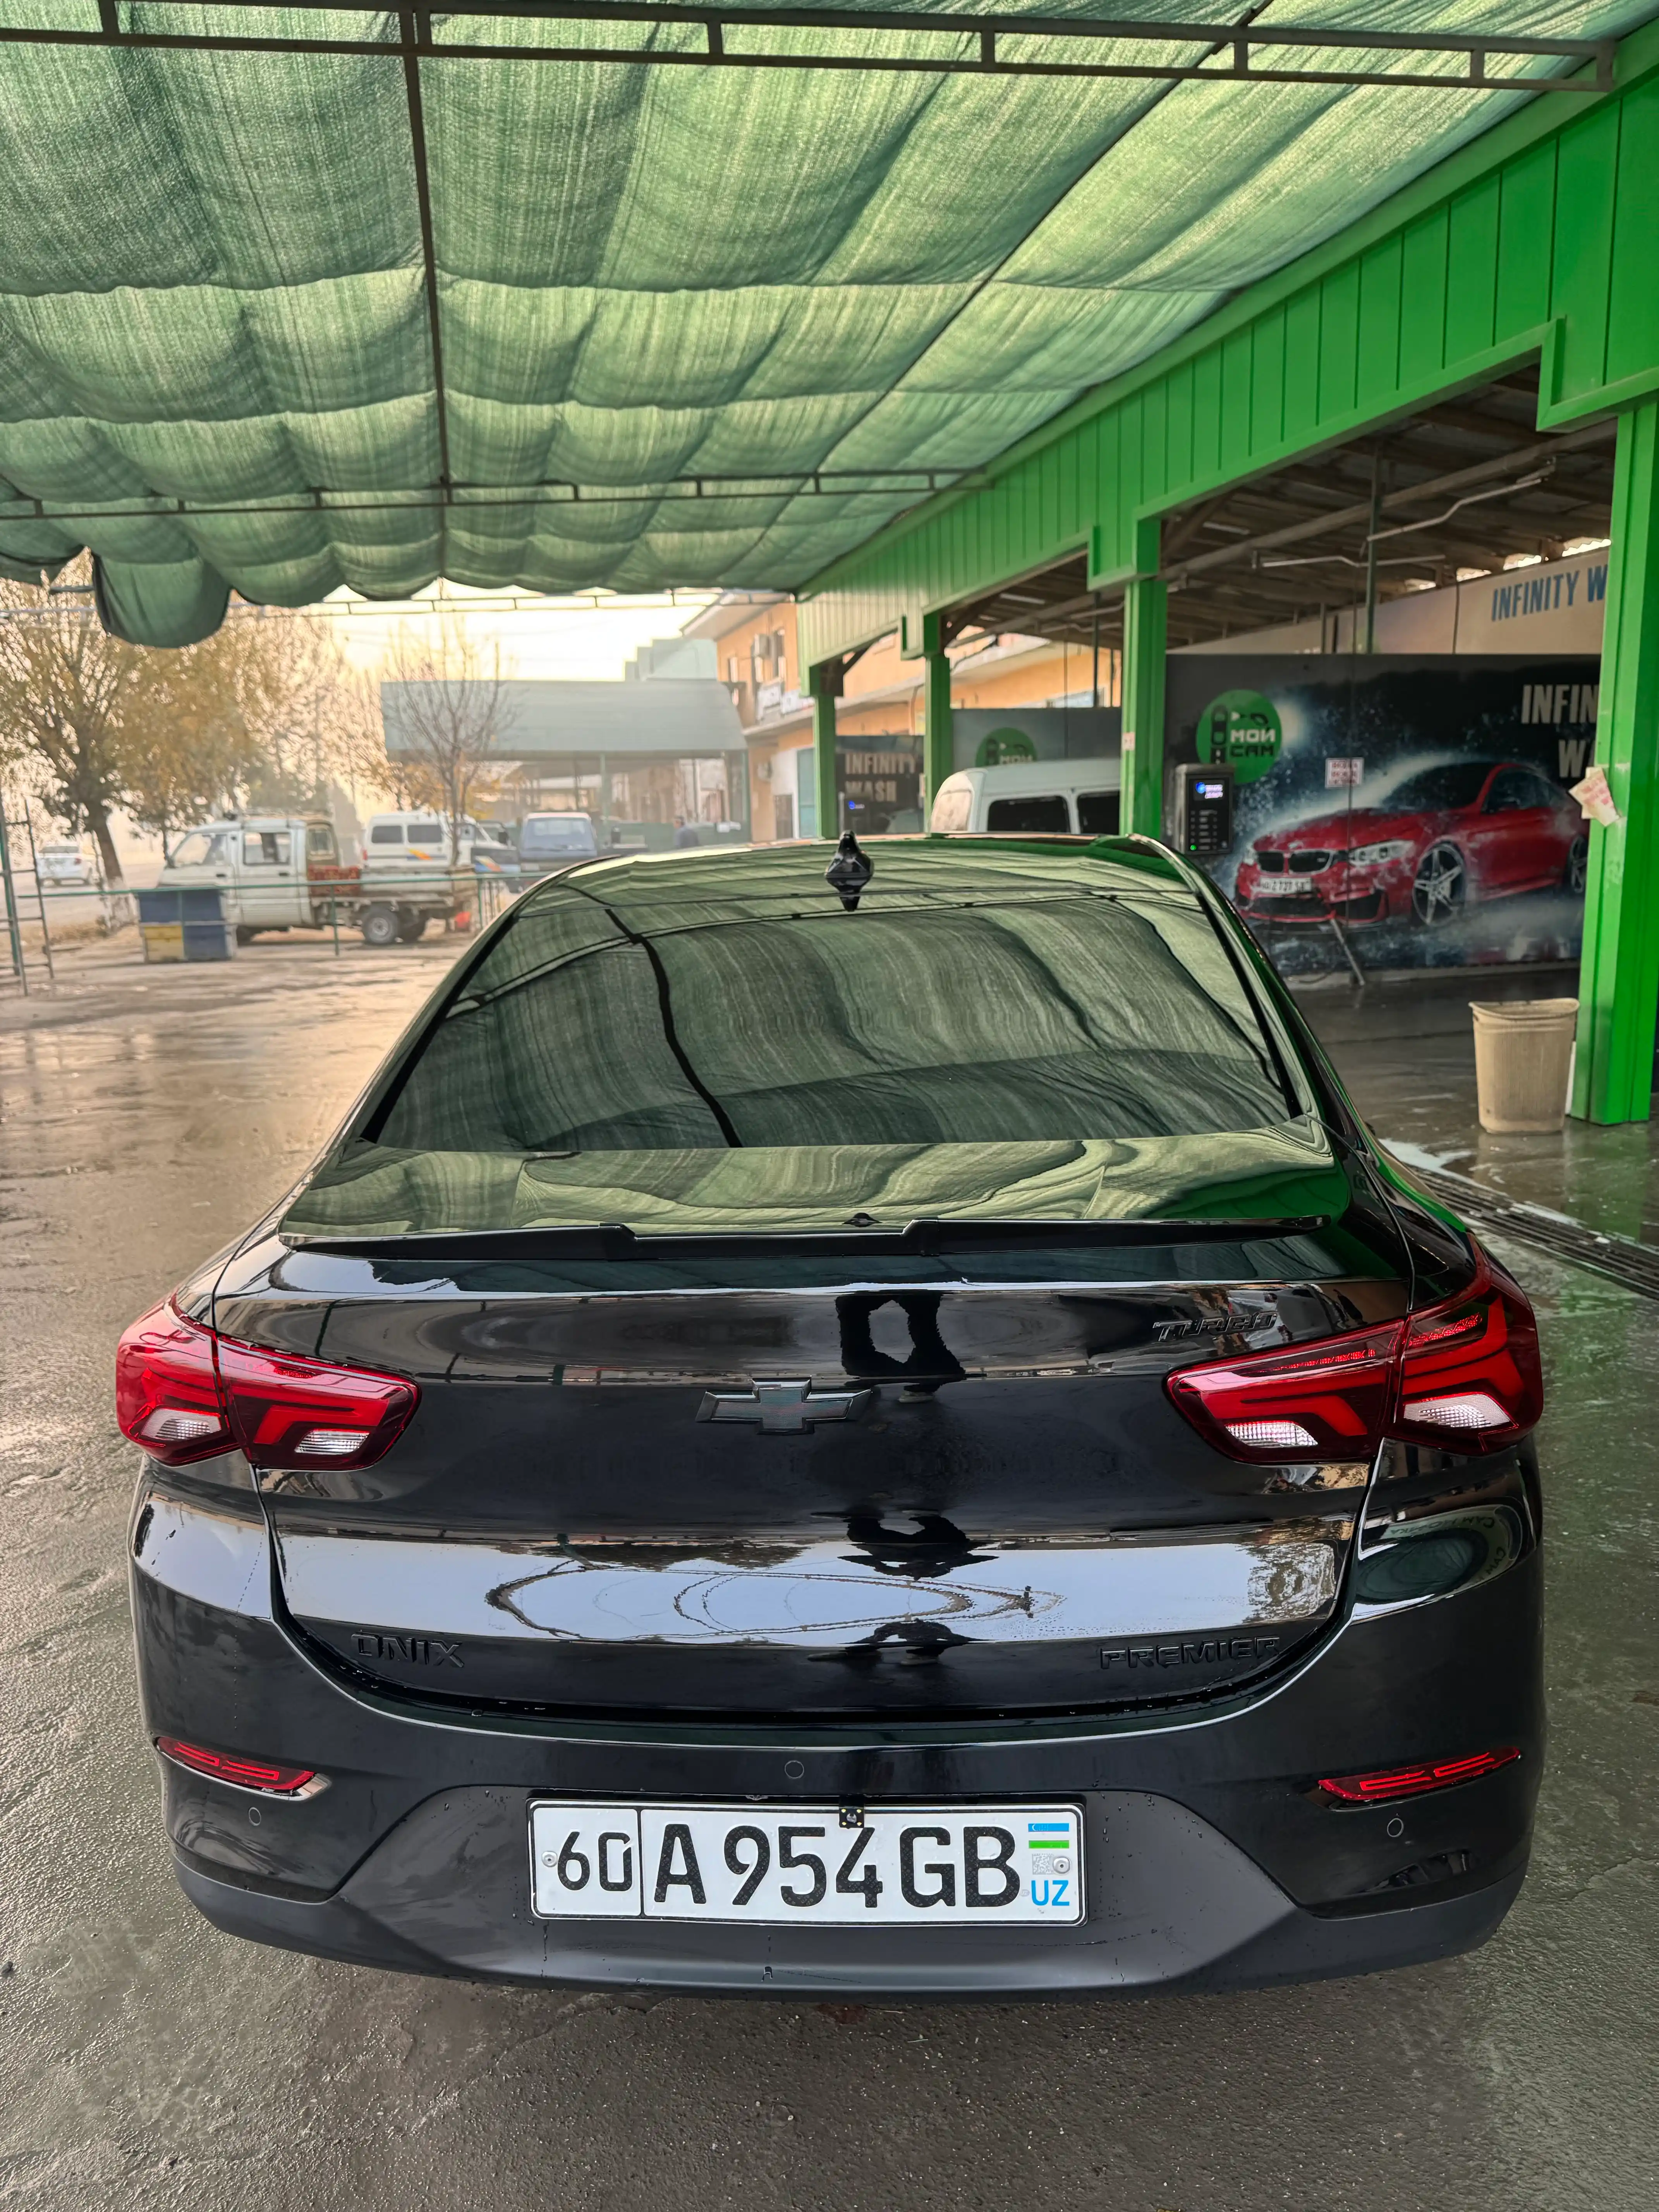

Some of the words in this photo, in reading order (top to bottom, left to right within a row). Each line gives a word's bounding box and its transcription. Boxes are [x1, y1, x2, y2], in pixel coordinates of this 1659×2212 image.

[1492, 570, 1580, 622] INFINITY
[845, 753, 915, 774] INFINITY
[1152, 1310, 1278, 1341] TURBO
[351, 1631, 464, 1668] ONIX
[1100, 1637, 1280, 1669] PREMIER
[557, 1831, 632, 1892] 60
[1031, 1880, 1070, 1906] UZ
